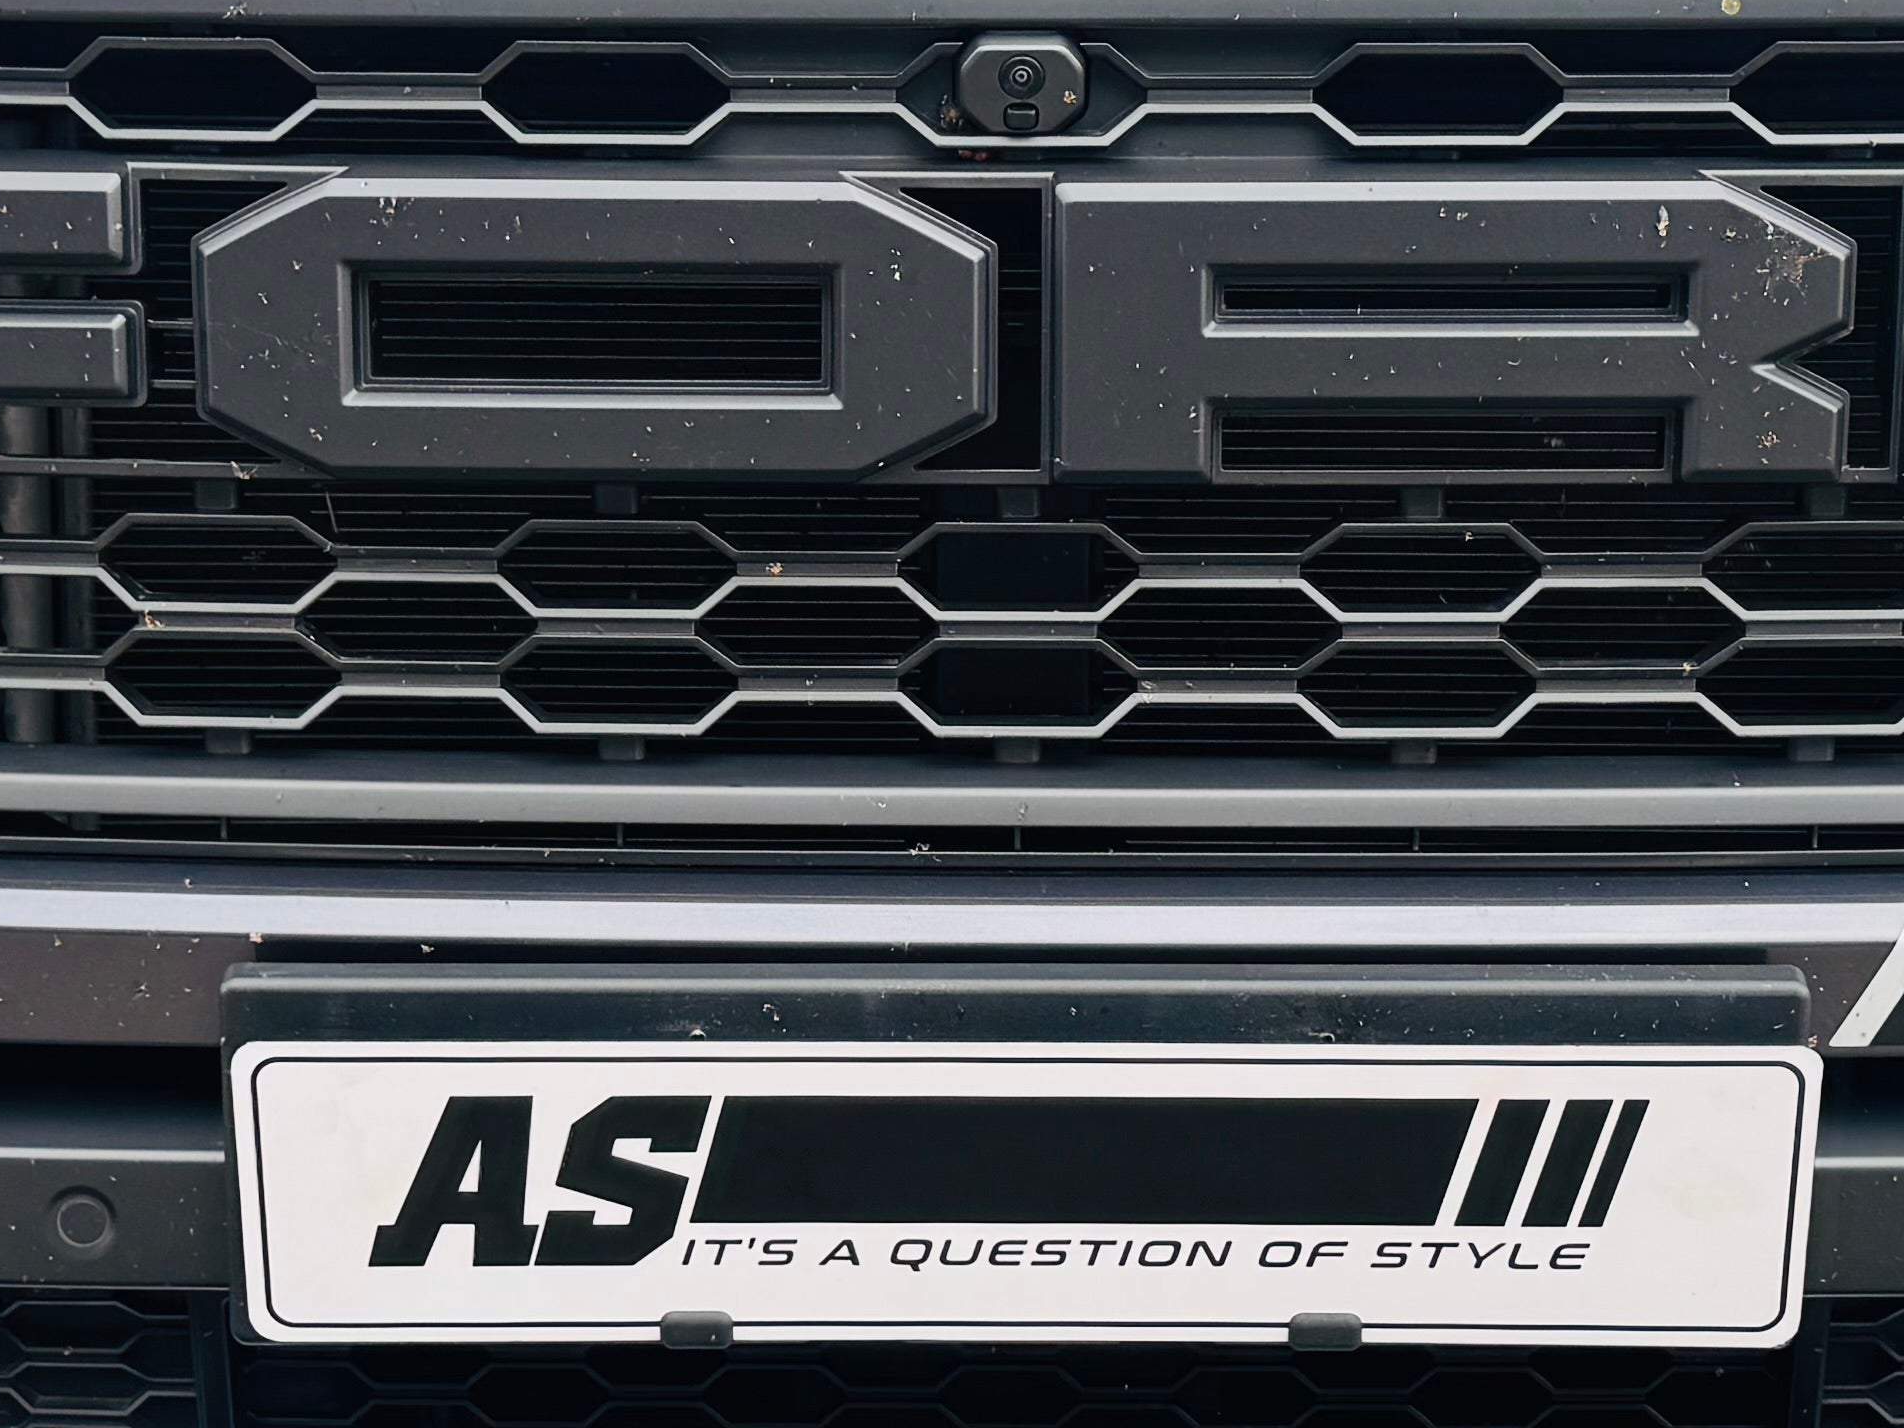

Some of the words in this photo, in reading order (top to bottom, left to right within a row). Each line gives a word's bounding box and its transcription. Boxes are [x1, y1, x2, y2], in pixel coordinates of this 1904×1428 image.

[368, 1094, 713, 1268] AS
[681, 1236, 798, 1269] IT'S
[818, 1236, 860, 1269] A
[890, 1236, 1233, 1272] QUESTION
[1258, 1236, 1349, 1270] OF
[1369, 1236, 1591, 1271] STYLE
